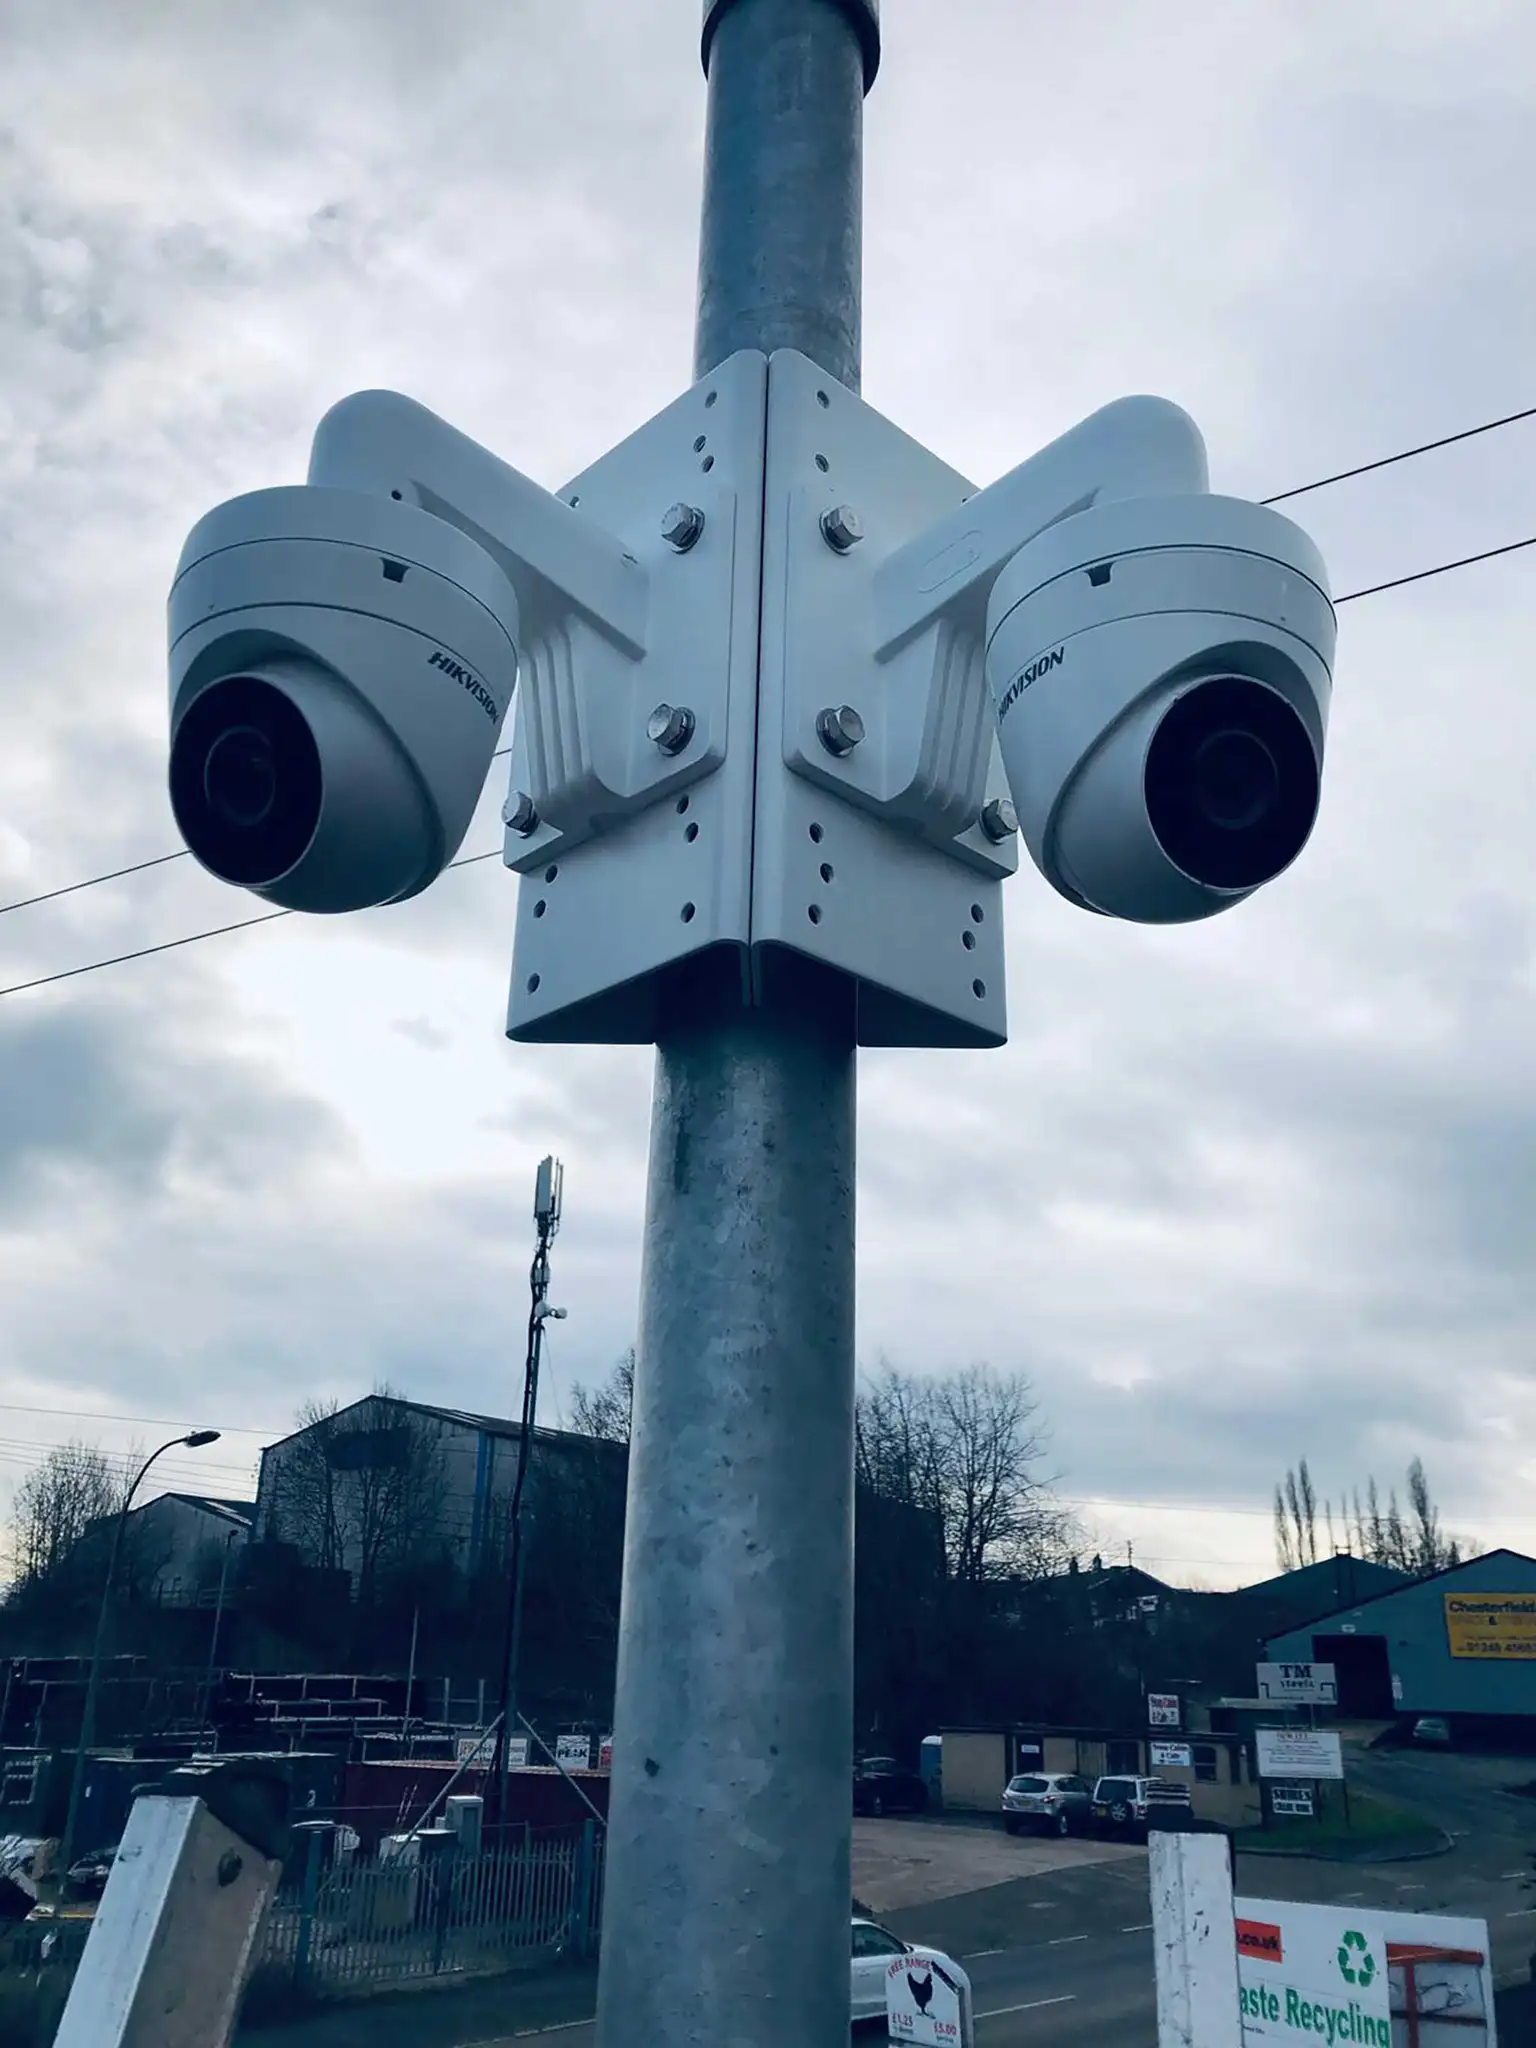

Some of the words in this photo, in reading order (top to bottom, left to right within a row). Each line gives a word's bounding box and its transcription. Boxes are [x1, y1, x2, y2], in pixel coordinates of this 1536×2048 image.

[428, 652, 499, 725] HIKVISION
[1279, 1664, 1313, 1678] TM
[1239, 1984, 1280, 2022] aste
[1285, 1988, 1391, 2048] Recycling
